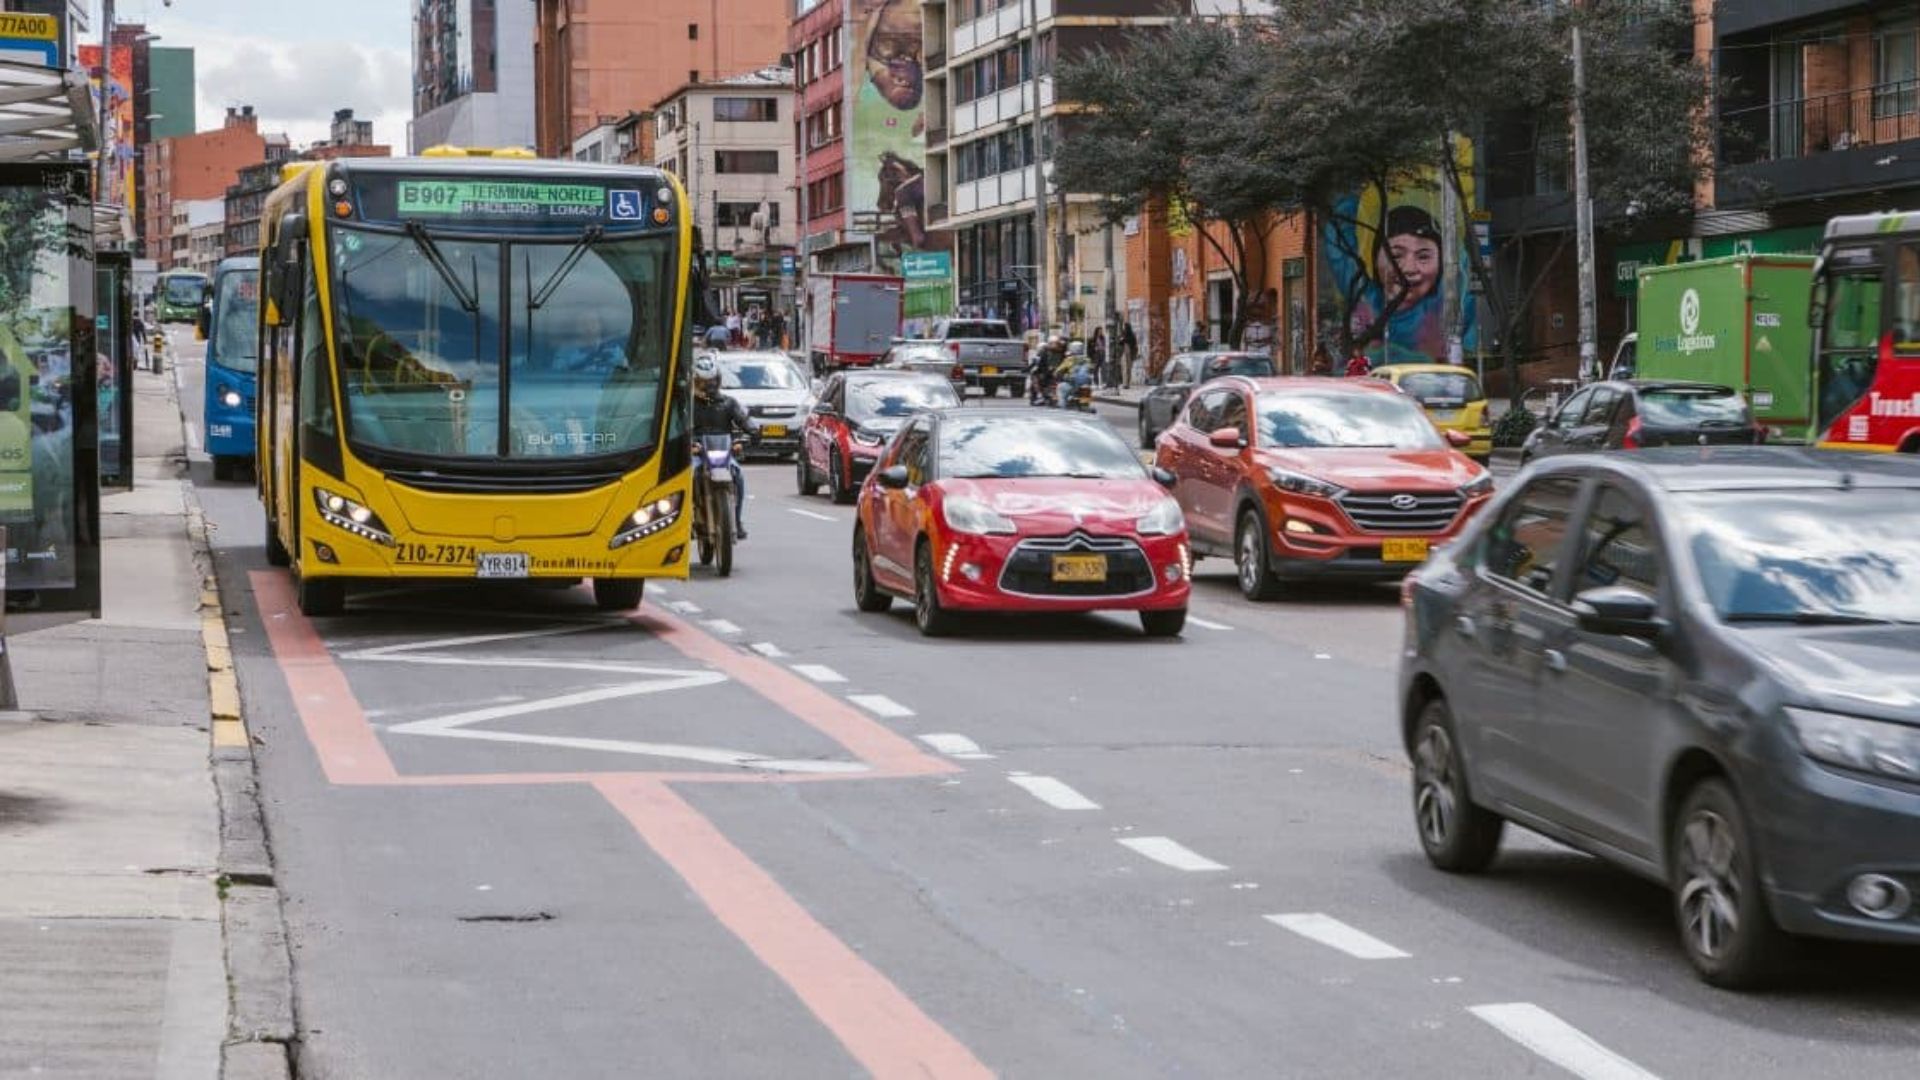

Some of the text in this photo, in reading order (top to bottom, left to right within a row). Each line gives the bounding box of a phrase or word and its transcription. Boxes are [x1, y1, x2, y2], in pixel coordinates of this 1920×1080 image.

[404, 187, 458, 204] B907
[470, 184, 600, 202] TERMINAL NORTE
[476, 202, 539, 215] MOLINOS
[528, 432, 616, 445] BUSSCAR
[396, 543, 476, 563] Z10-7374
